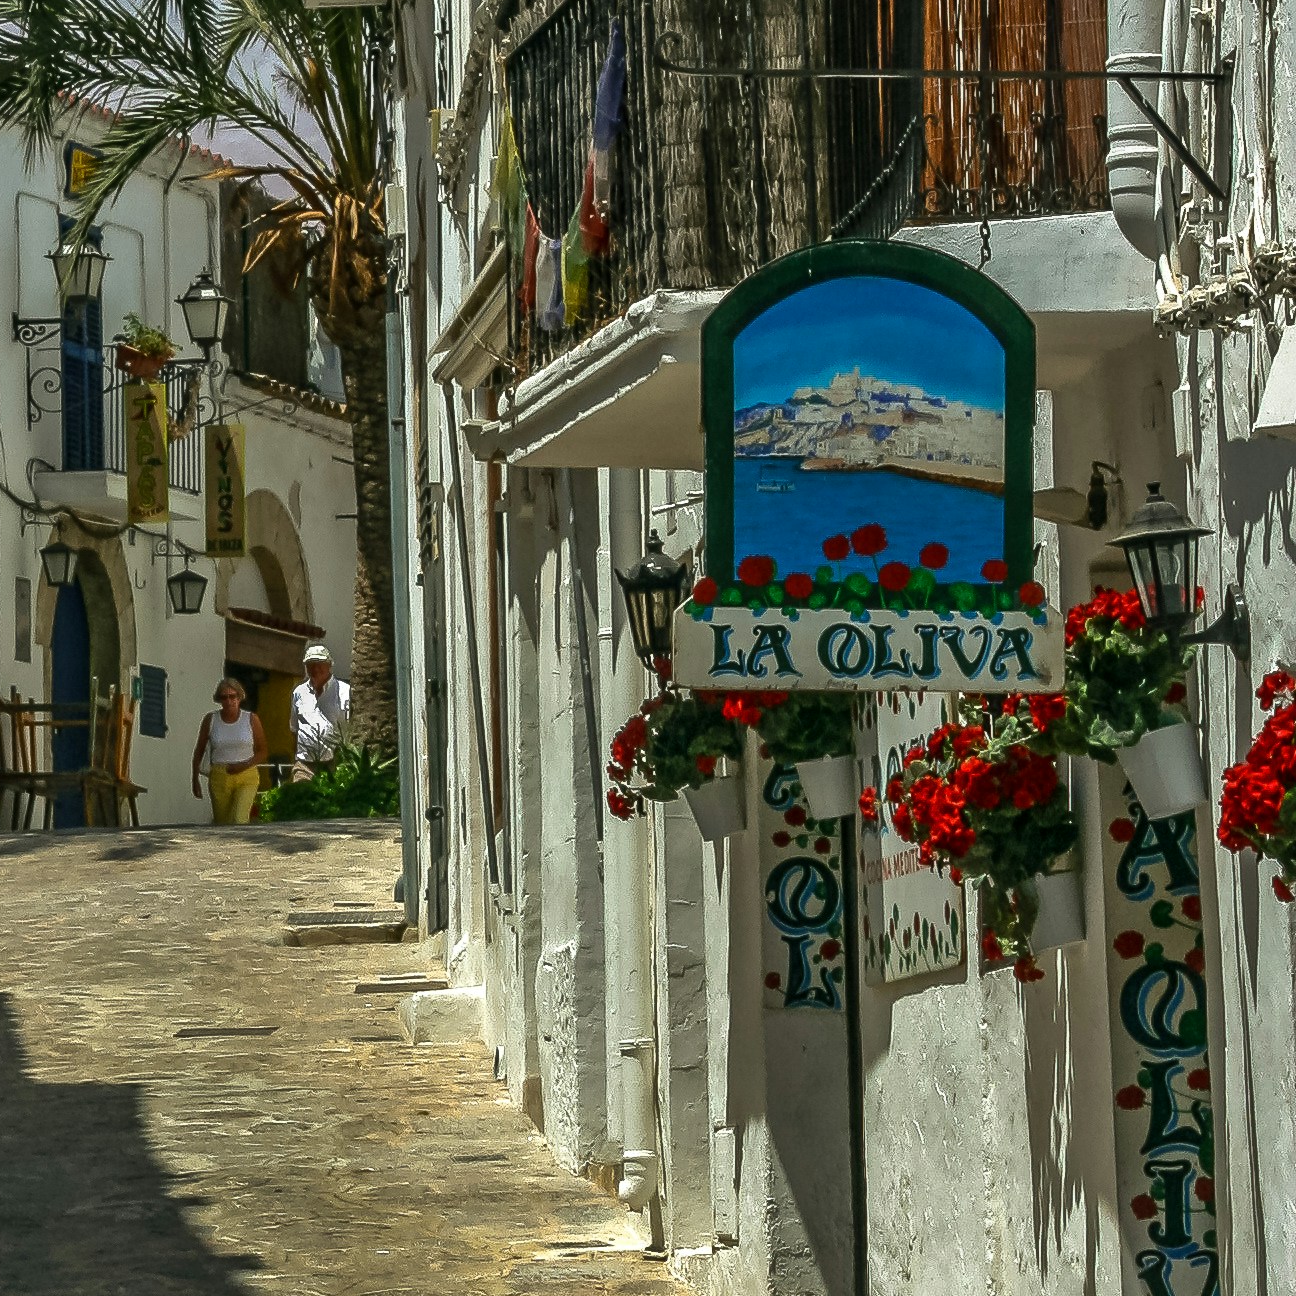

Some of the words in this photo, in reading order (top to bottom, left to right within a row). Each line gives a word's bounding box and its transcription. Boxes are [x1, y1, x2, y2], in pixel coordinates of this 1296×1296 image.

[215, 435, 234, 533] VINOS
[707, 622, 803, 678] LA
[816, 621, 1045, 681] OLIVA
